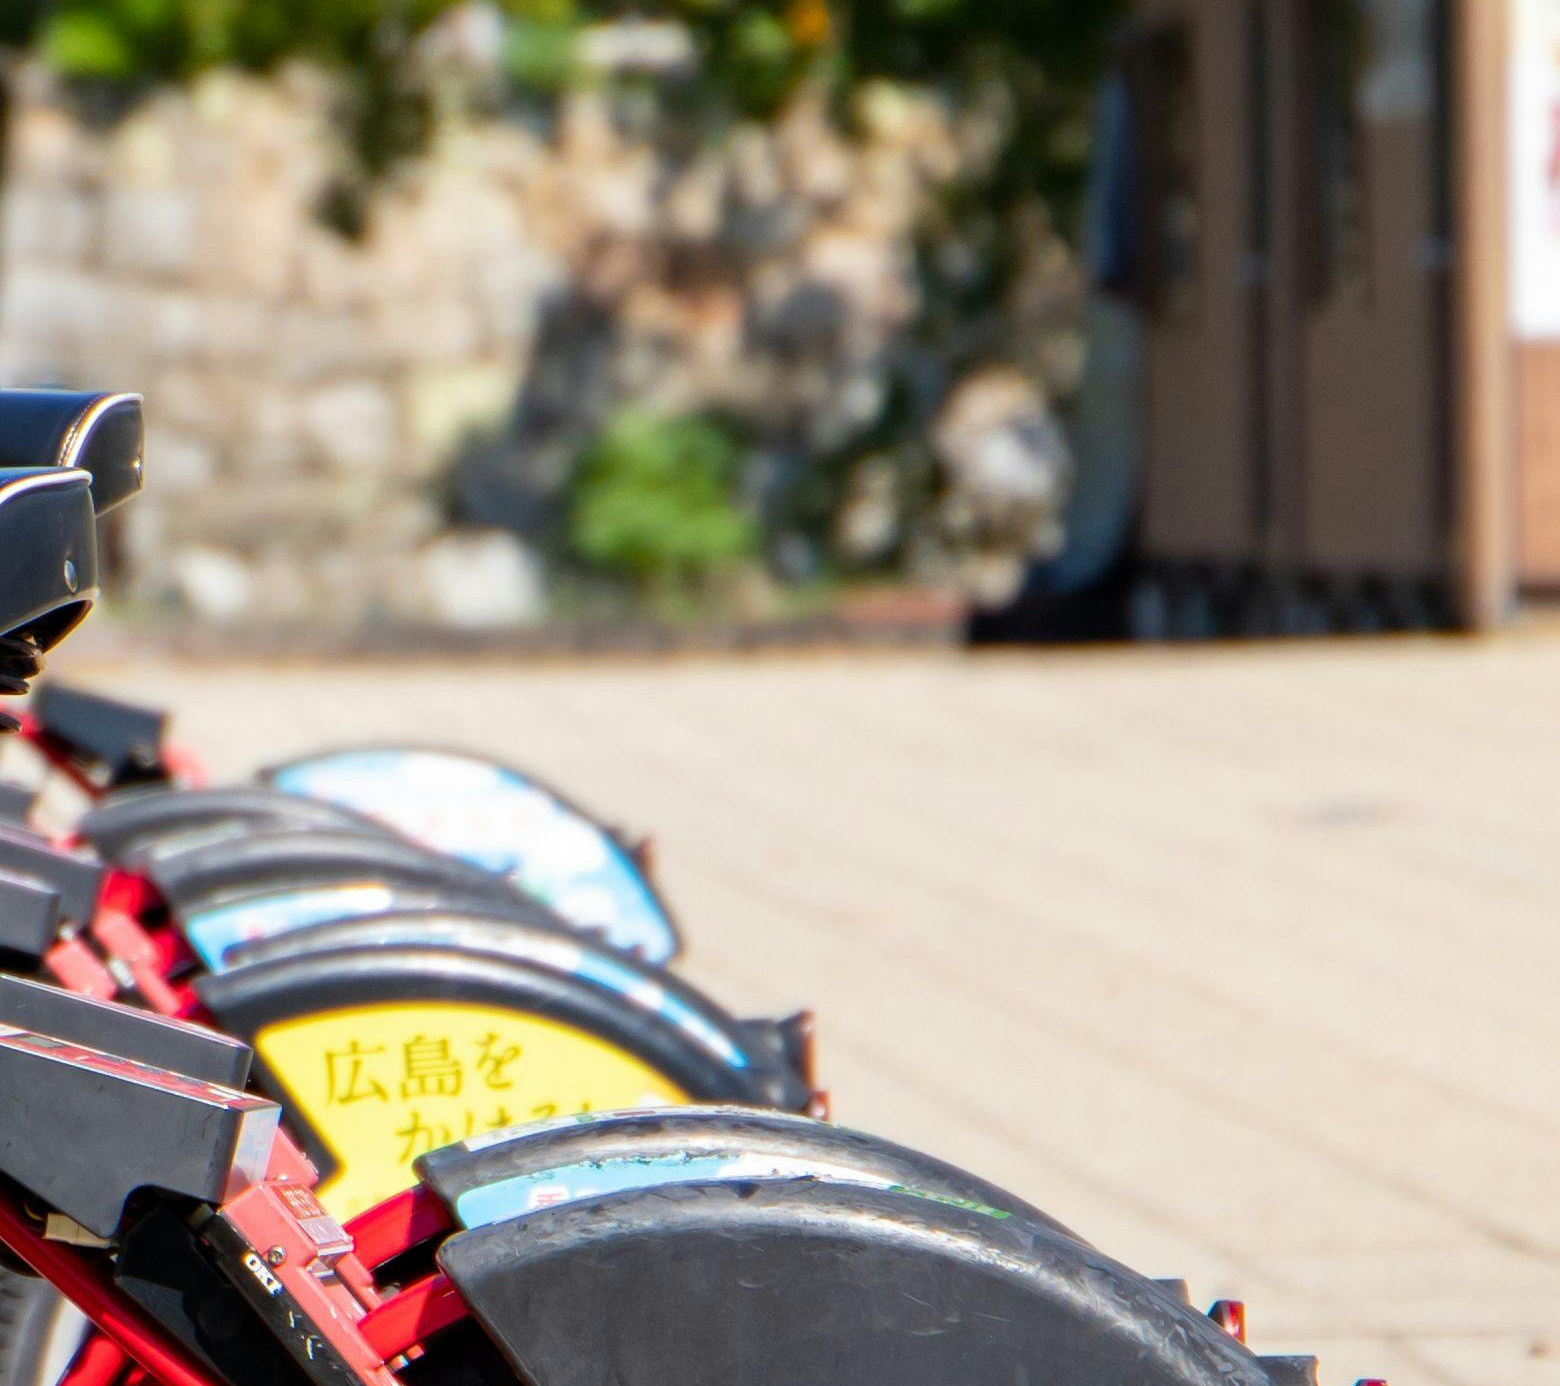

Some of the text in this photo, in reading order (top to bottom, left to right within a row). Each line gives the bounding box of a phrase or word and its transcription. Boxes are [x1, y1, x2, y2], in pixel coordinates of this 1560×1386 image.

[323, 1029, 522, 1107] 広島を
[243, 1253, 282, 1297] OKI
